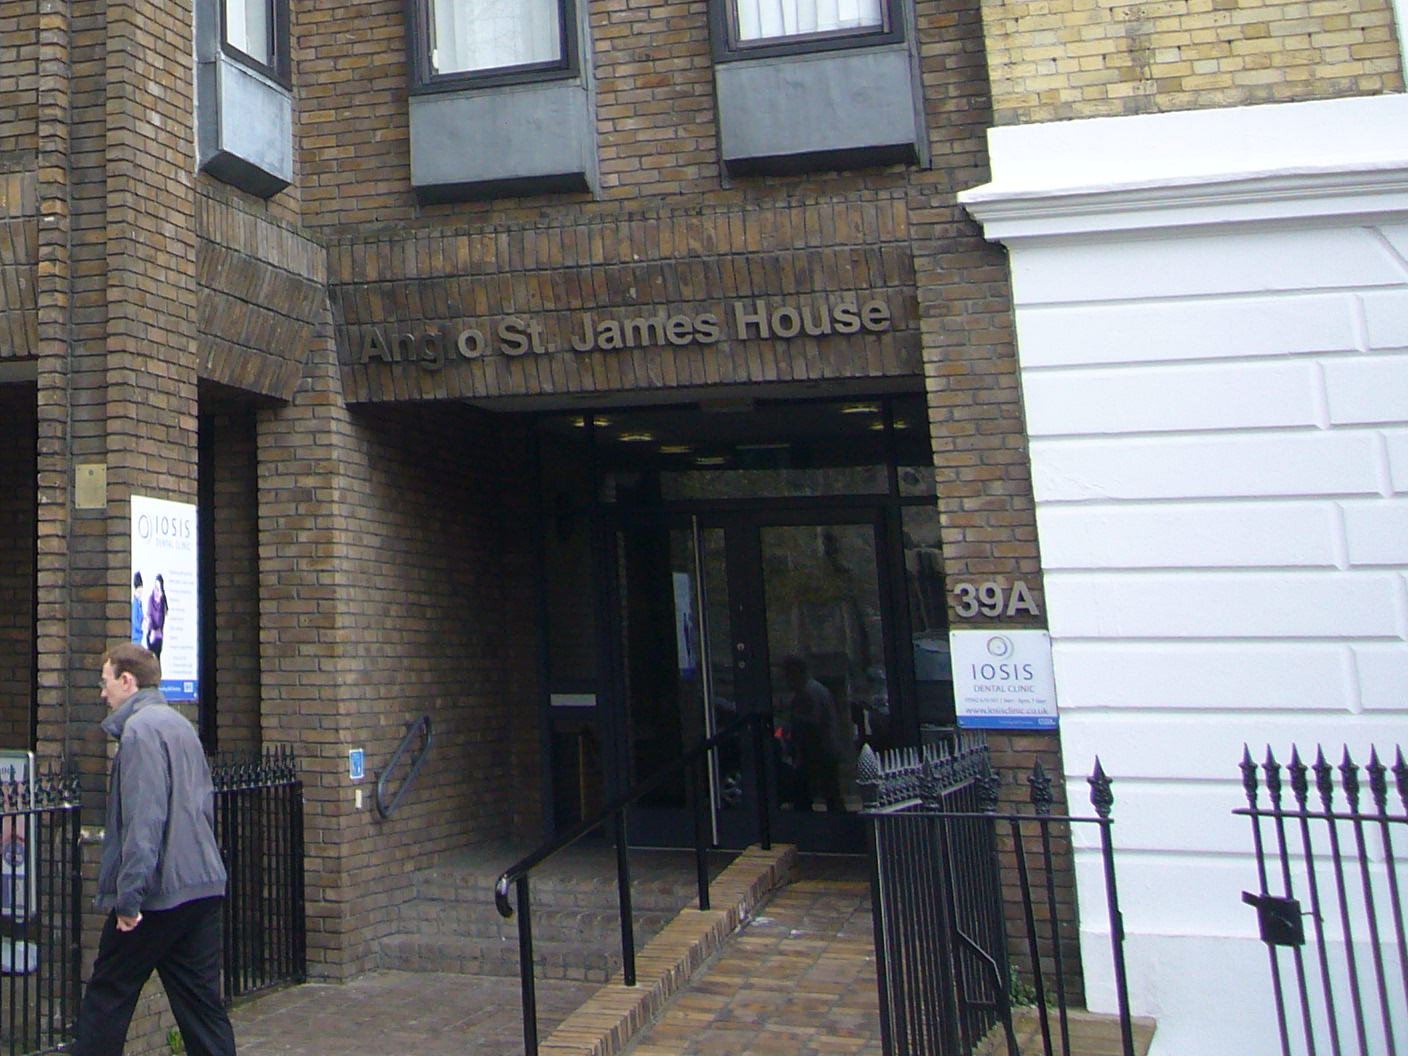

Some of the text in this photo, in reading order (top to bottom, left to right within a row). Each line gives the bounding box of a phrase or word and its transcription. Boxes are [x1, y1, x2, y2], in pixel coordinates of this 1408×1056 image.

[571, 311, 719, 351] James
[734, 299, 891, 340] House
[155, 515, 191, 538] IOSIS
[953, 580, 1040, 618] 39A
[971, 663, 1034, 681] IOSIS
[974, 684, 1036, 693] DENTAL CLINIC
